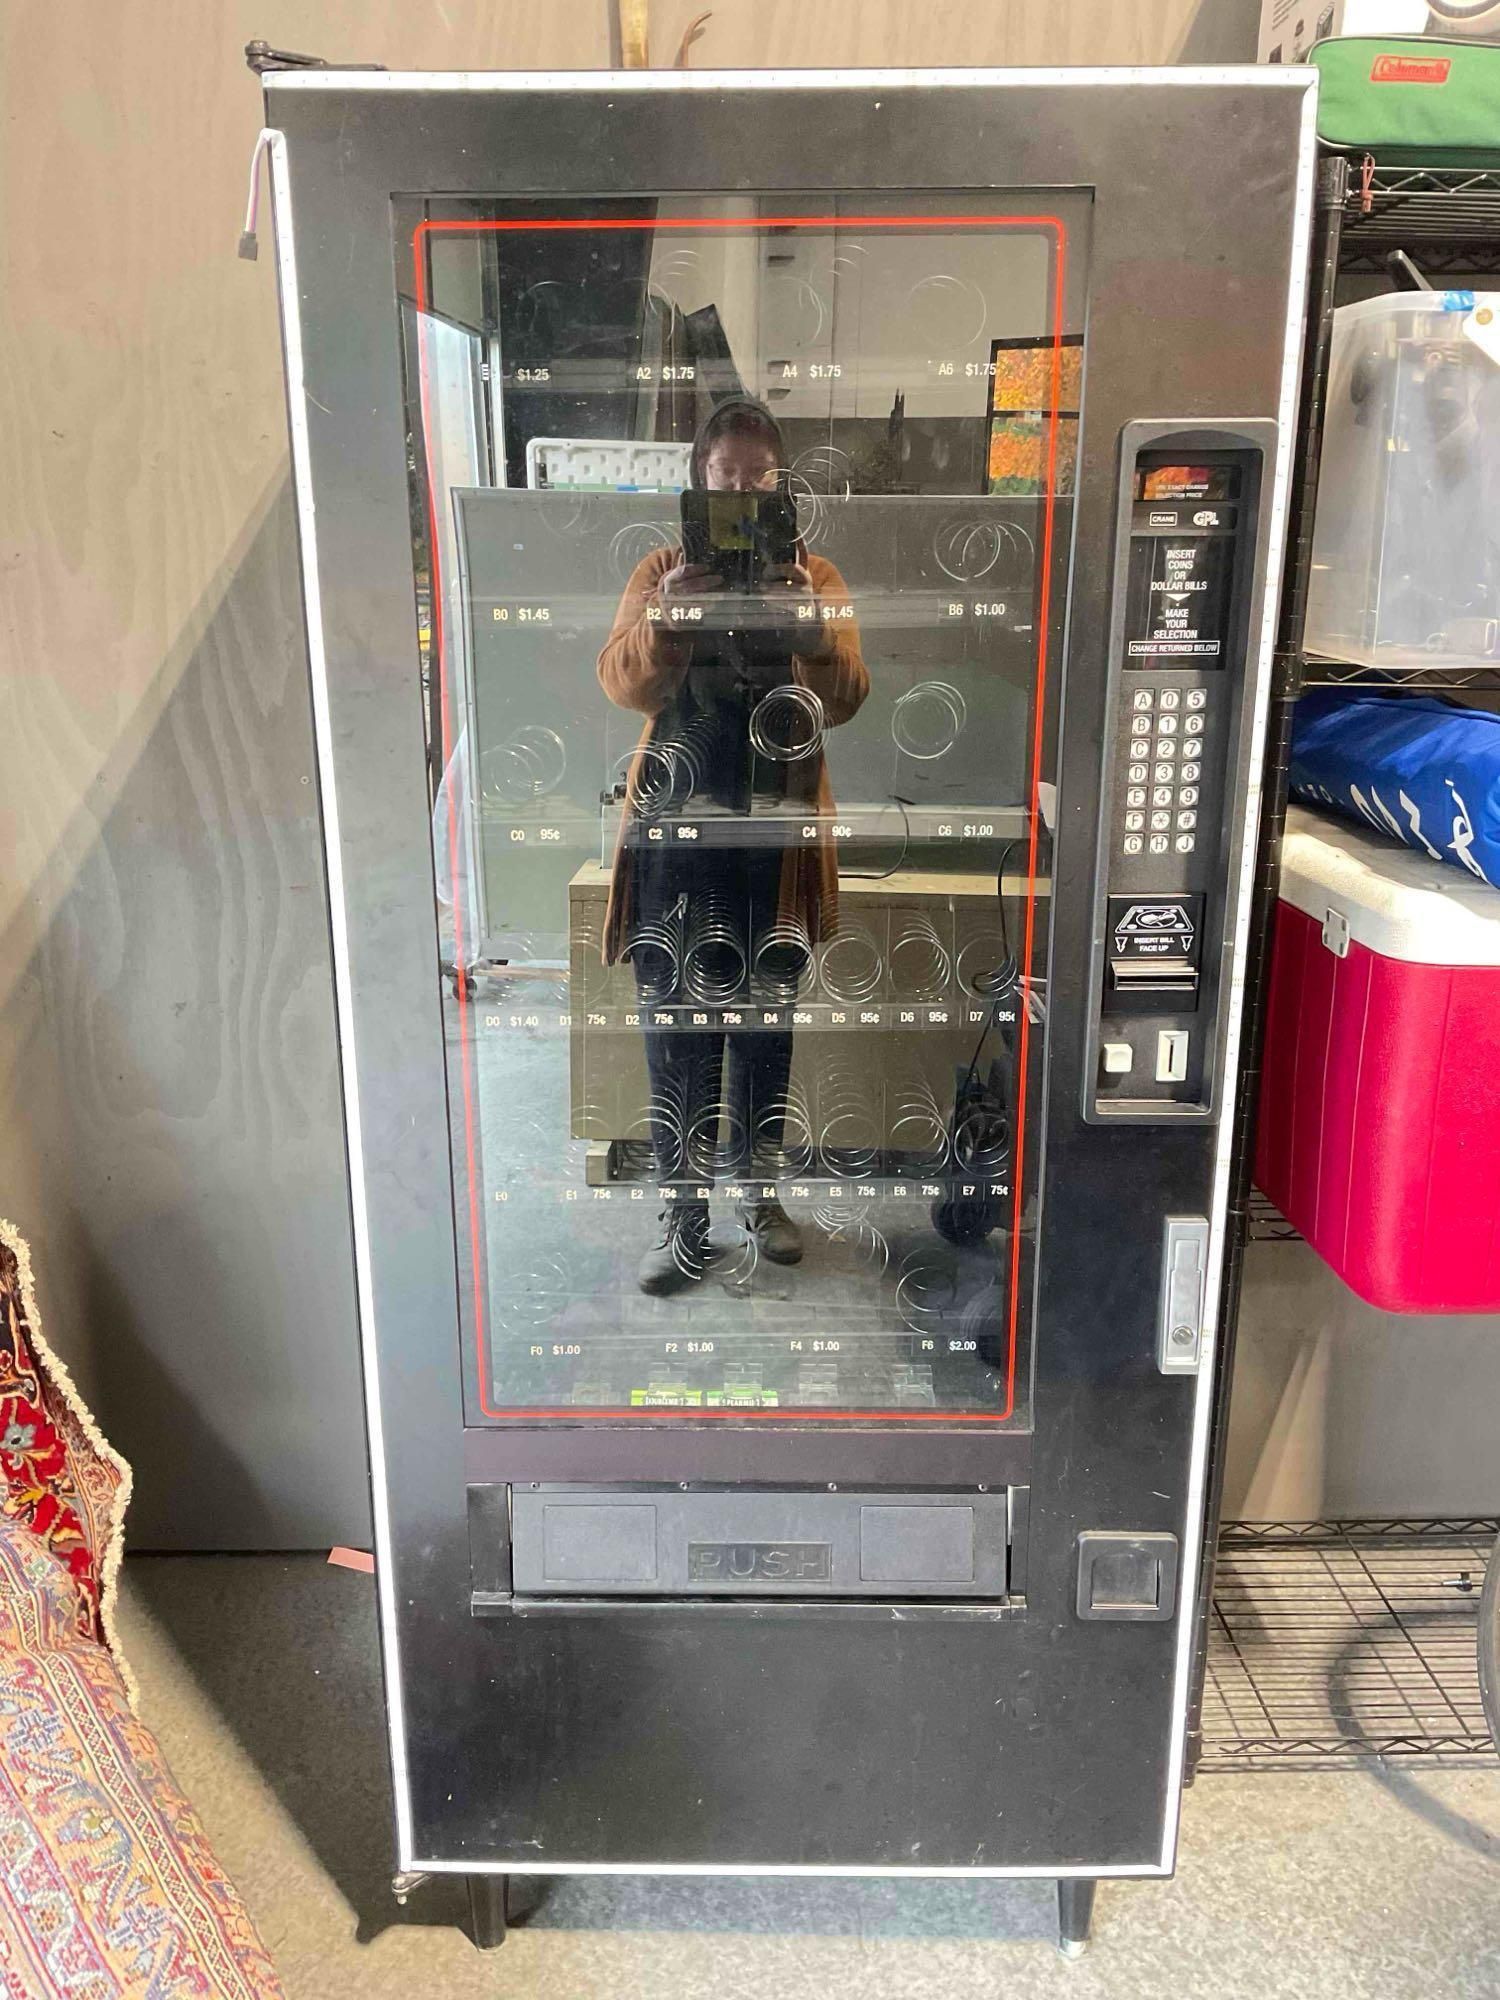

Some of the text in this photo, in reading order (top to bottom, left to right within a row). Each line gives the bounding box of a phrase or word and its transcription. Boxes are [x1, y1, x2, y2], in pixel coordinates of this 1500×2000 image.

[517, 368, 550, 382] $1.25
[636, 366, 695, 381] A2 $1.75
[783, 364, 841, 378] A4 $1.75
[939, 363, 997, 376] A6 $1.75
[1152, 515, 1174, 523] CRANE
[1167, 549, 1196, 559] INSERT
[1168, 561, 1193, 570] COINS
[1174, 571, 1186, 580] OR
[1151, 581, 1207, 591] DOLLAR BILLS
[493, 607, 549, 621] B0 $1.45
[646, 607, 702, 621] B2 $1.45
[798, 605, 854, 620] B4 $1.45
[949, 603, 1005, 617] B6 $1.00
[1165, 608, 1189, 618] MAKE
[1166, 619, 1188, 628] YOUR
[1153, 630, 1198, 639] SELECTION
[1131, 644, 1217, 652] CHANGE RETURNED BELOW
[1138, 693, 1200, 707] A 0 5
[1137, 718, 1198, 731] B 1 6
[1135, 742, 1196, 755] C 2 7
[1134, 766, 1194, 779] D 3 8
[1133, 790, 1193, 803] E 4 9
[1131, 814, 1139, 827] F
[510, 828, 560, 841] C0 95¢
[648, 827, 697, 840] C2 95¢
[802, 825, 852, 838] C4 90¢
[938, 824, 993, 837] C6 $1.00
[1129, 837, 1189, 850] G H J
[486, 1015, 538, 1027] D0 $1.40
[559, 1014, 607, 1026] D1 75¢
[625, 1013, 673, 1026] D2 75¢
[693, 1013, 741, 1024] D3 75¢
[763, 1012, 812, 1024] D4 95¢
[831, 1012, 880, 1024] D5 95¢
[900, 1011, 948, 1023] D6 95¢
[969, 1011, 983, 1022] D7
[566, 1189, 611, 1200] E1 75¢
[631, 1188, 677, 1199] E2 75¢
[697, 1188, 709, 1199] E3
[762, 1186, 809, 1198] E4 75¢
[829, 1185, 875, 1197] E5 75¢
[894, 1185, 939, 1196] E6 75¢
[962, 1185, 1008, 1196] E7 75¢
[530, 1344, 581, 1356] F0 $1.00
[665, 1341, 714, 1353] F2 $1.00
[790, 1340, 840, 1351] F4 $1.00
[921, 1339, 976, 1351] F6 $2.00
[694, 1548, 826, 1577] PUSH
